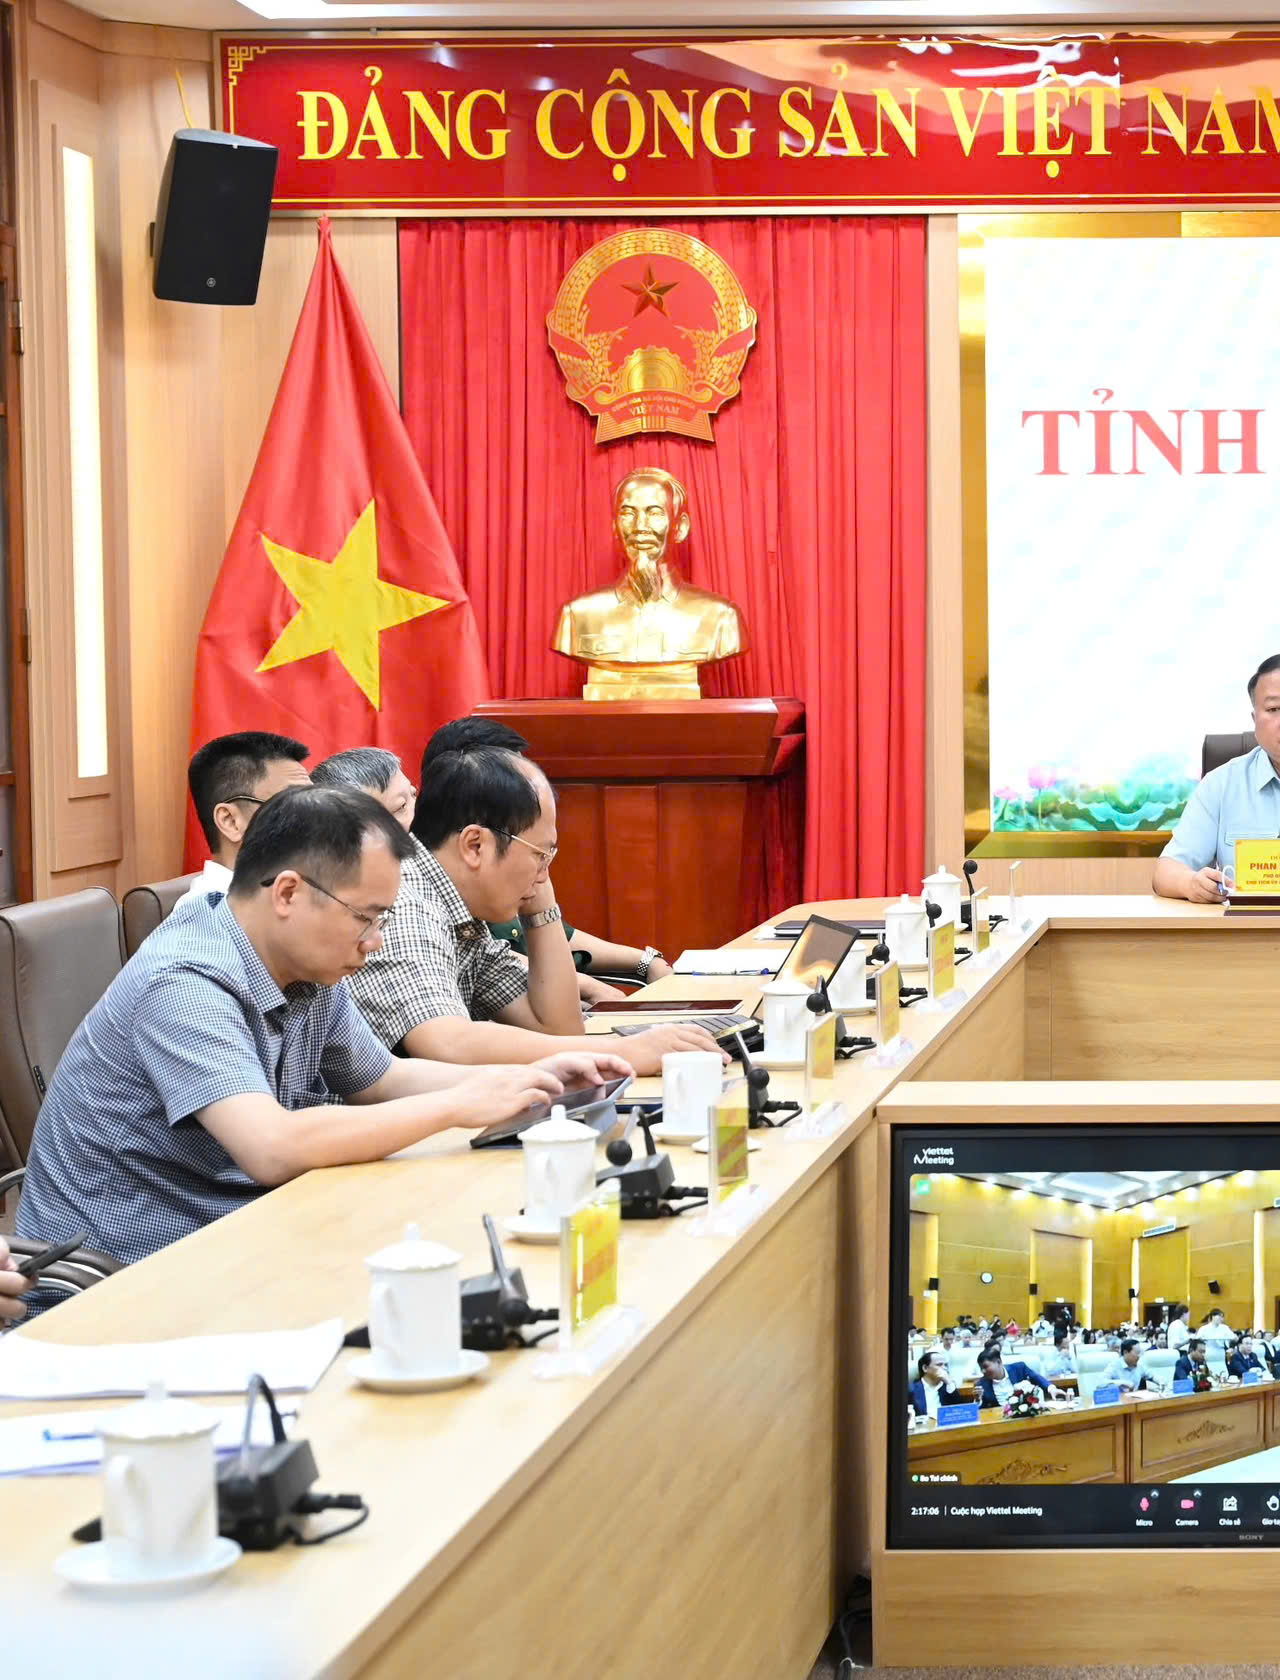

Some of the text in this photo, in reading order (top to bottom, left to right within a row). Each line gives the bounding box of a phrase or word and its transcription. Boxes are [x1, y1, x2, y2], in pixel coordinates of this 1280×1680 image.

[297, 65, 511, 160] ĐẢNG
[535, 68, 756, 182] CỘNG
[778, 63, 921, 158] SẢN
[941, 65, 1121, 178] VIỆT
[1021, 387, 1267, 475] TỈNH
[911, 1507, 940, 1516] 2:17:06
[950, 1506, 970, 1517] Cuộc
[986, 1506, 1012, 1516] Viettel
[1012, 1506, 1043, 1517] Meeting
[1175, 1518, 1199, 1526] Camera
